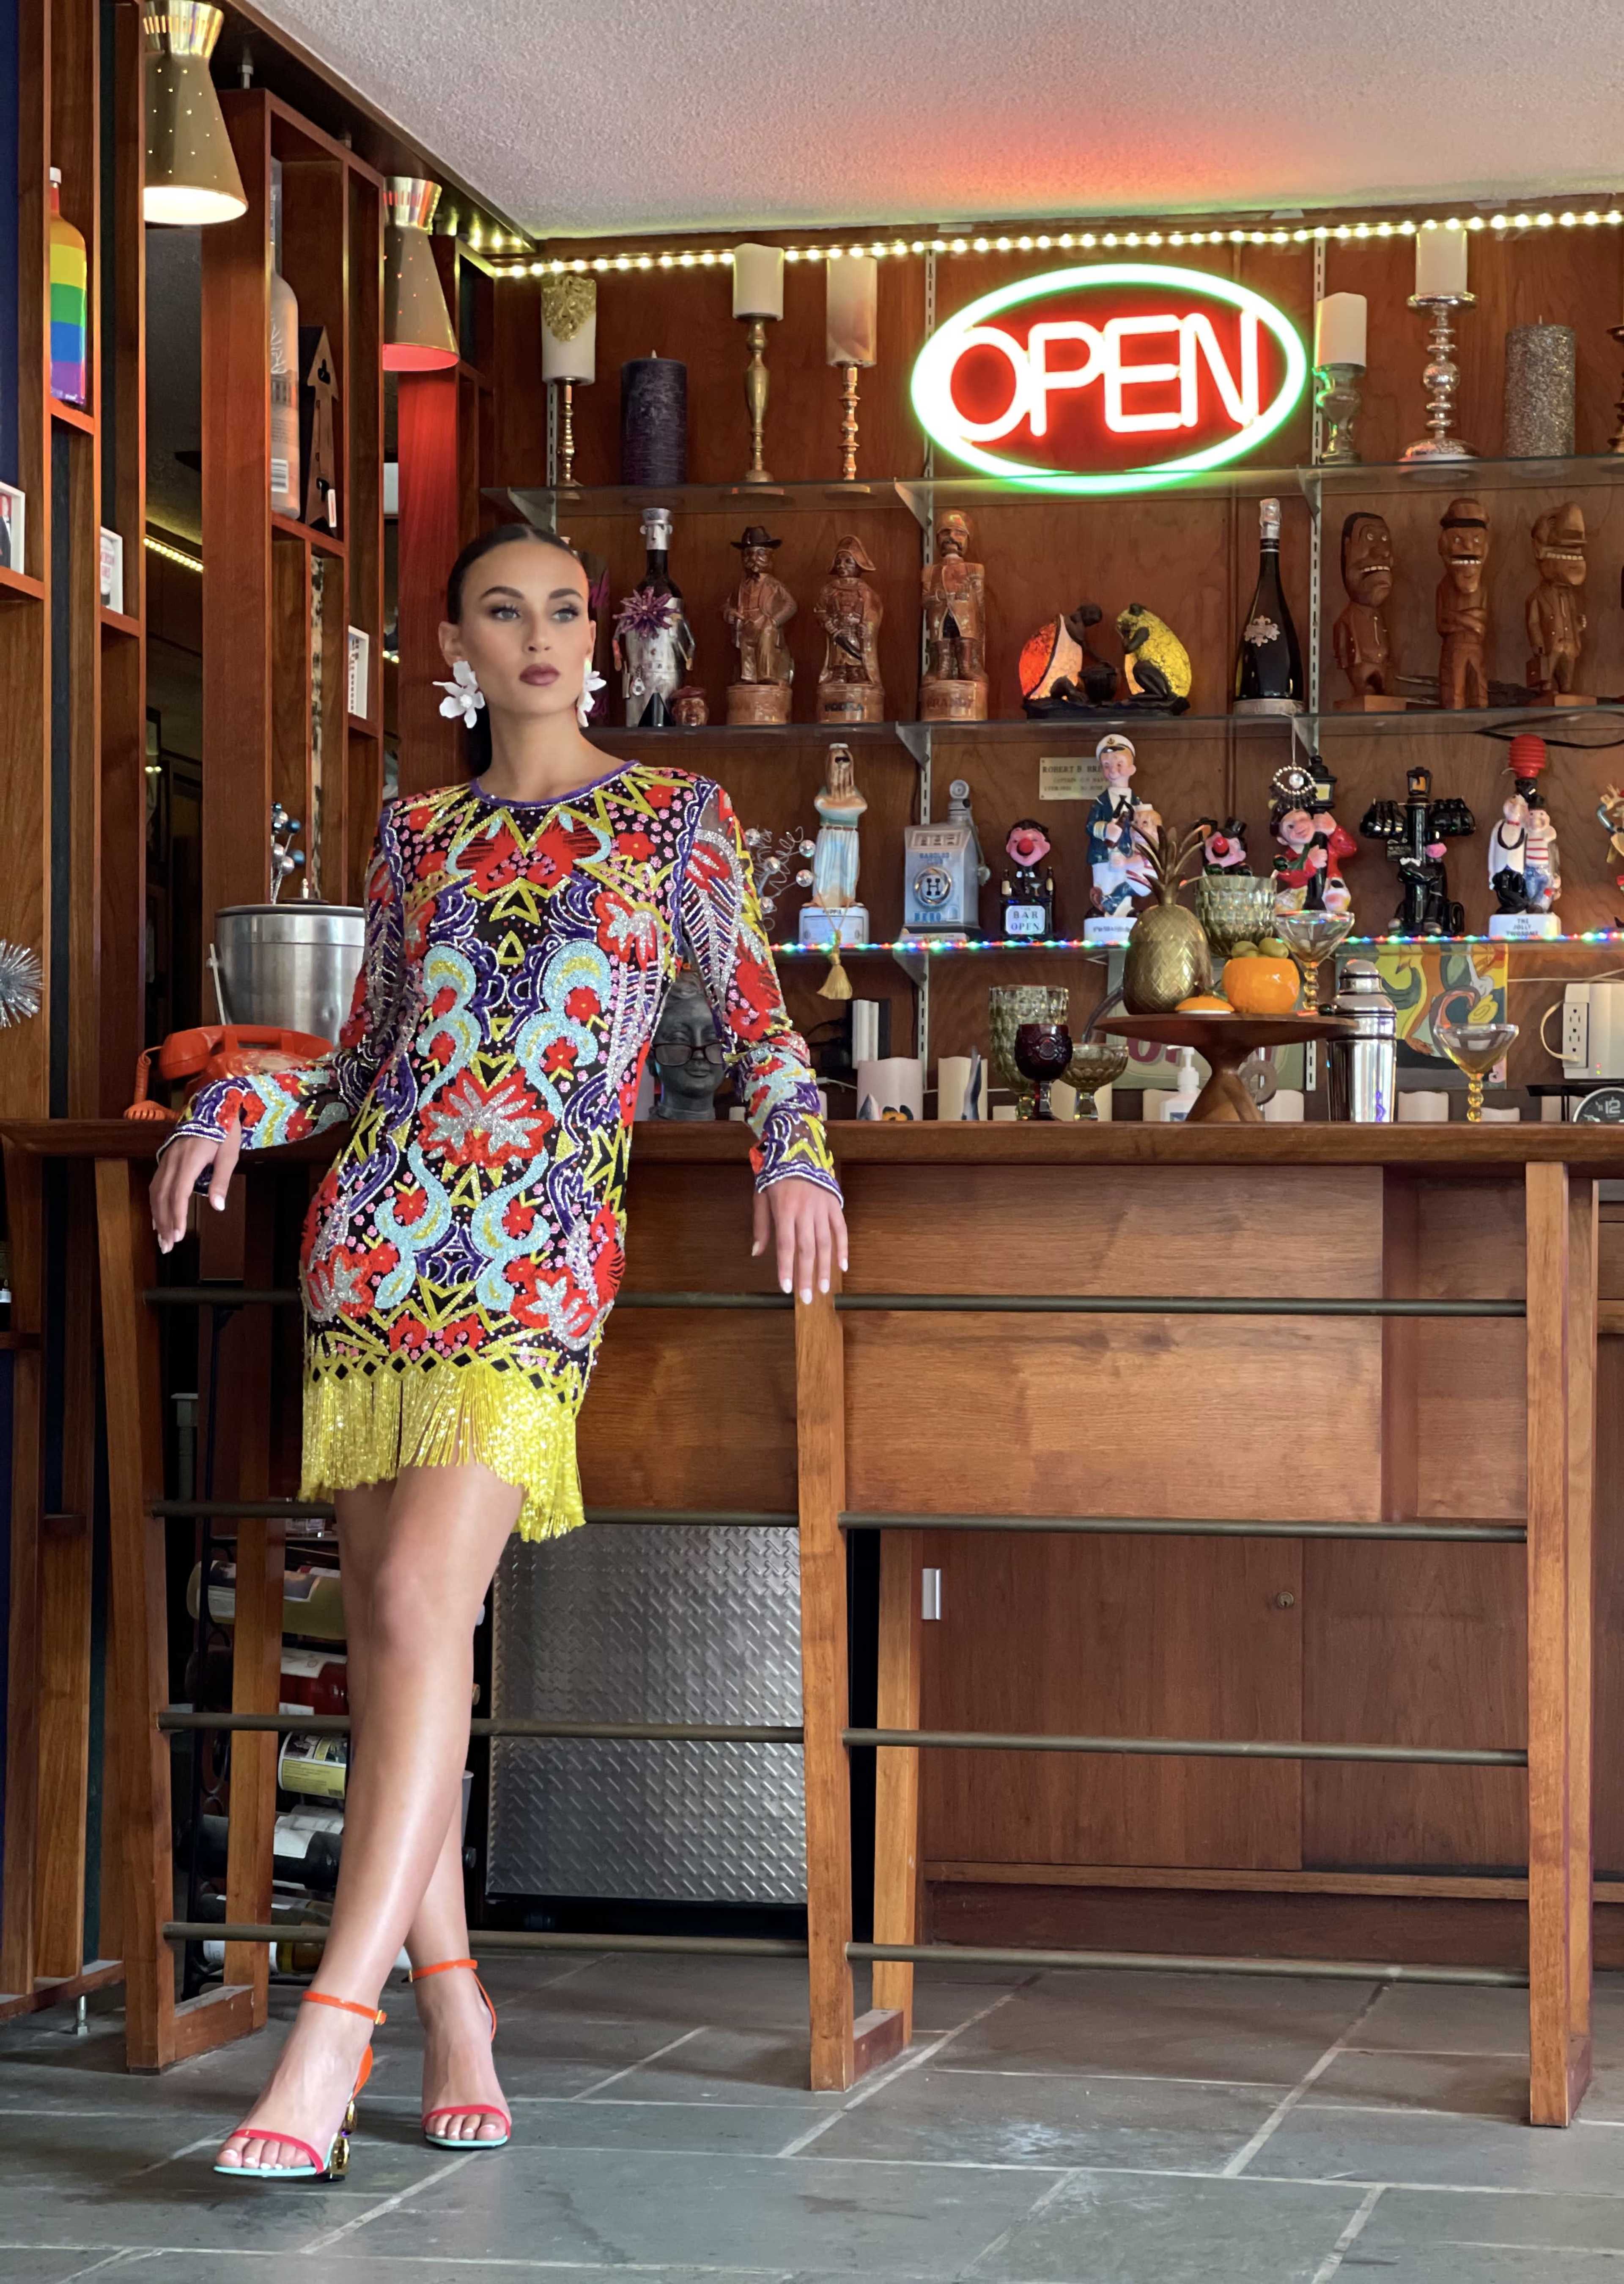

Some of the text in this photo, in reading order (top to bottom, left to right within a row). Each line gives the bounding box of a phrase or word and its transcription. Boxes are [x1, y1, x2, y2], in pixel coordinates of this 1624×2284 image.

[935, 311, 1259, 442] OPEN
[926, 878, 940, 896] H
[1605, 1099, 1621, 1114] 12
